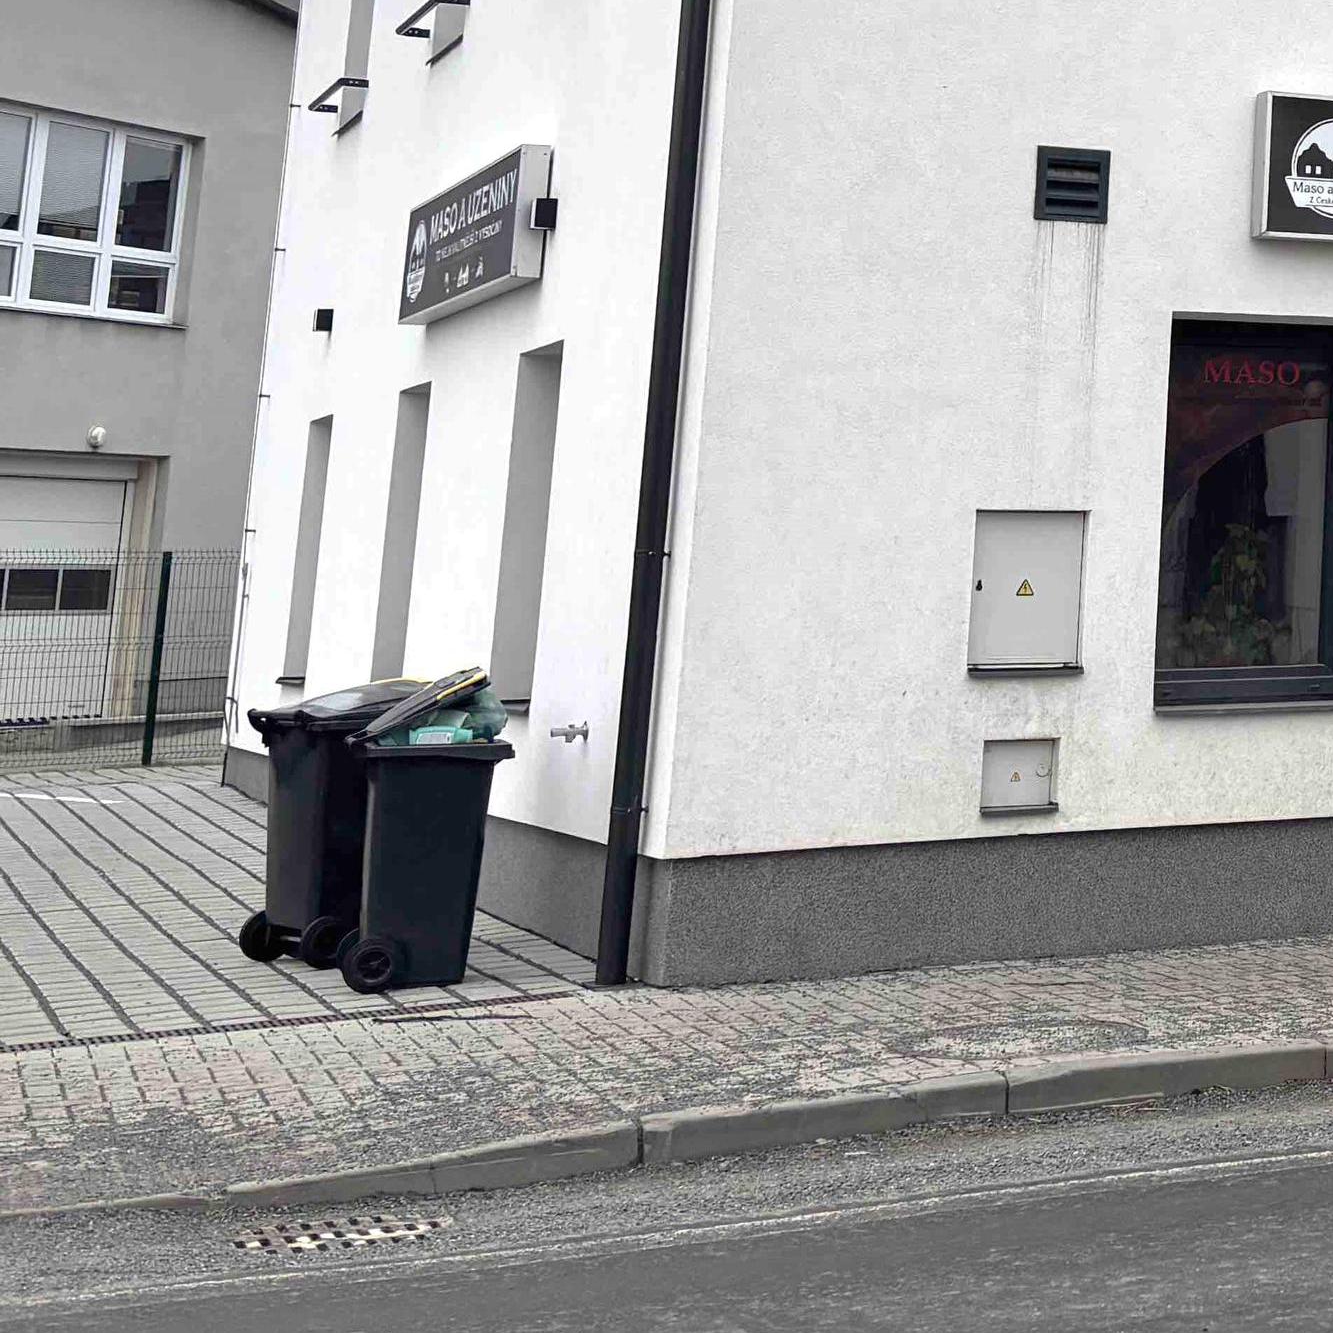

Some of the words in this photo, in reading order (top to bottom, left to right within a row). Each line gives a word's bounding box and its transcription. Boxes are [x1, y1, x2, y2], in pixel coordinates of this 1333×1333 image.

[1292, 181, 1325, 194] Maso
[1327, 186, 1333, 194] a
[429, 201, 458, 246] MASO
[457, 197, 466, 231] A
[467, 168, 518, 225] UZENINY
[1202, 359, 1301, 386] MASO
